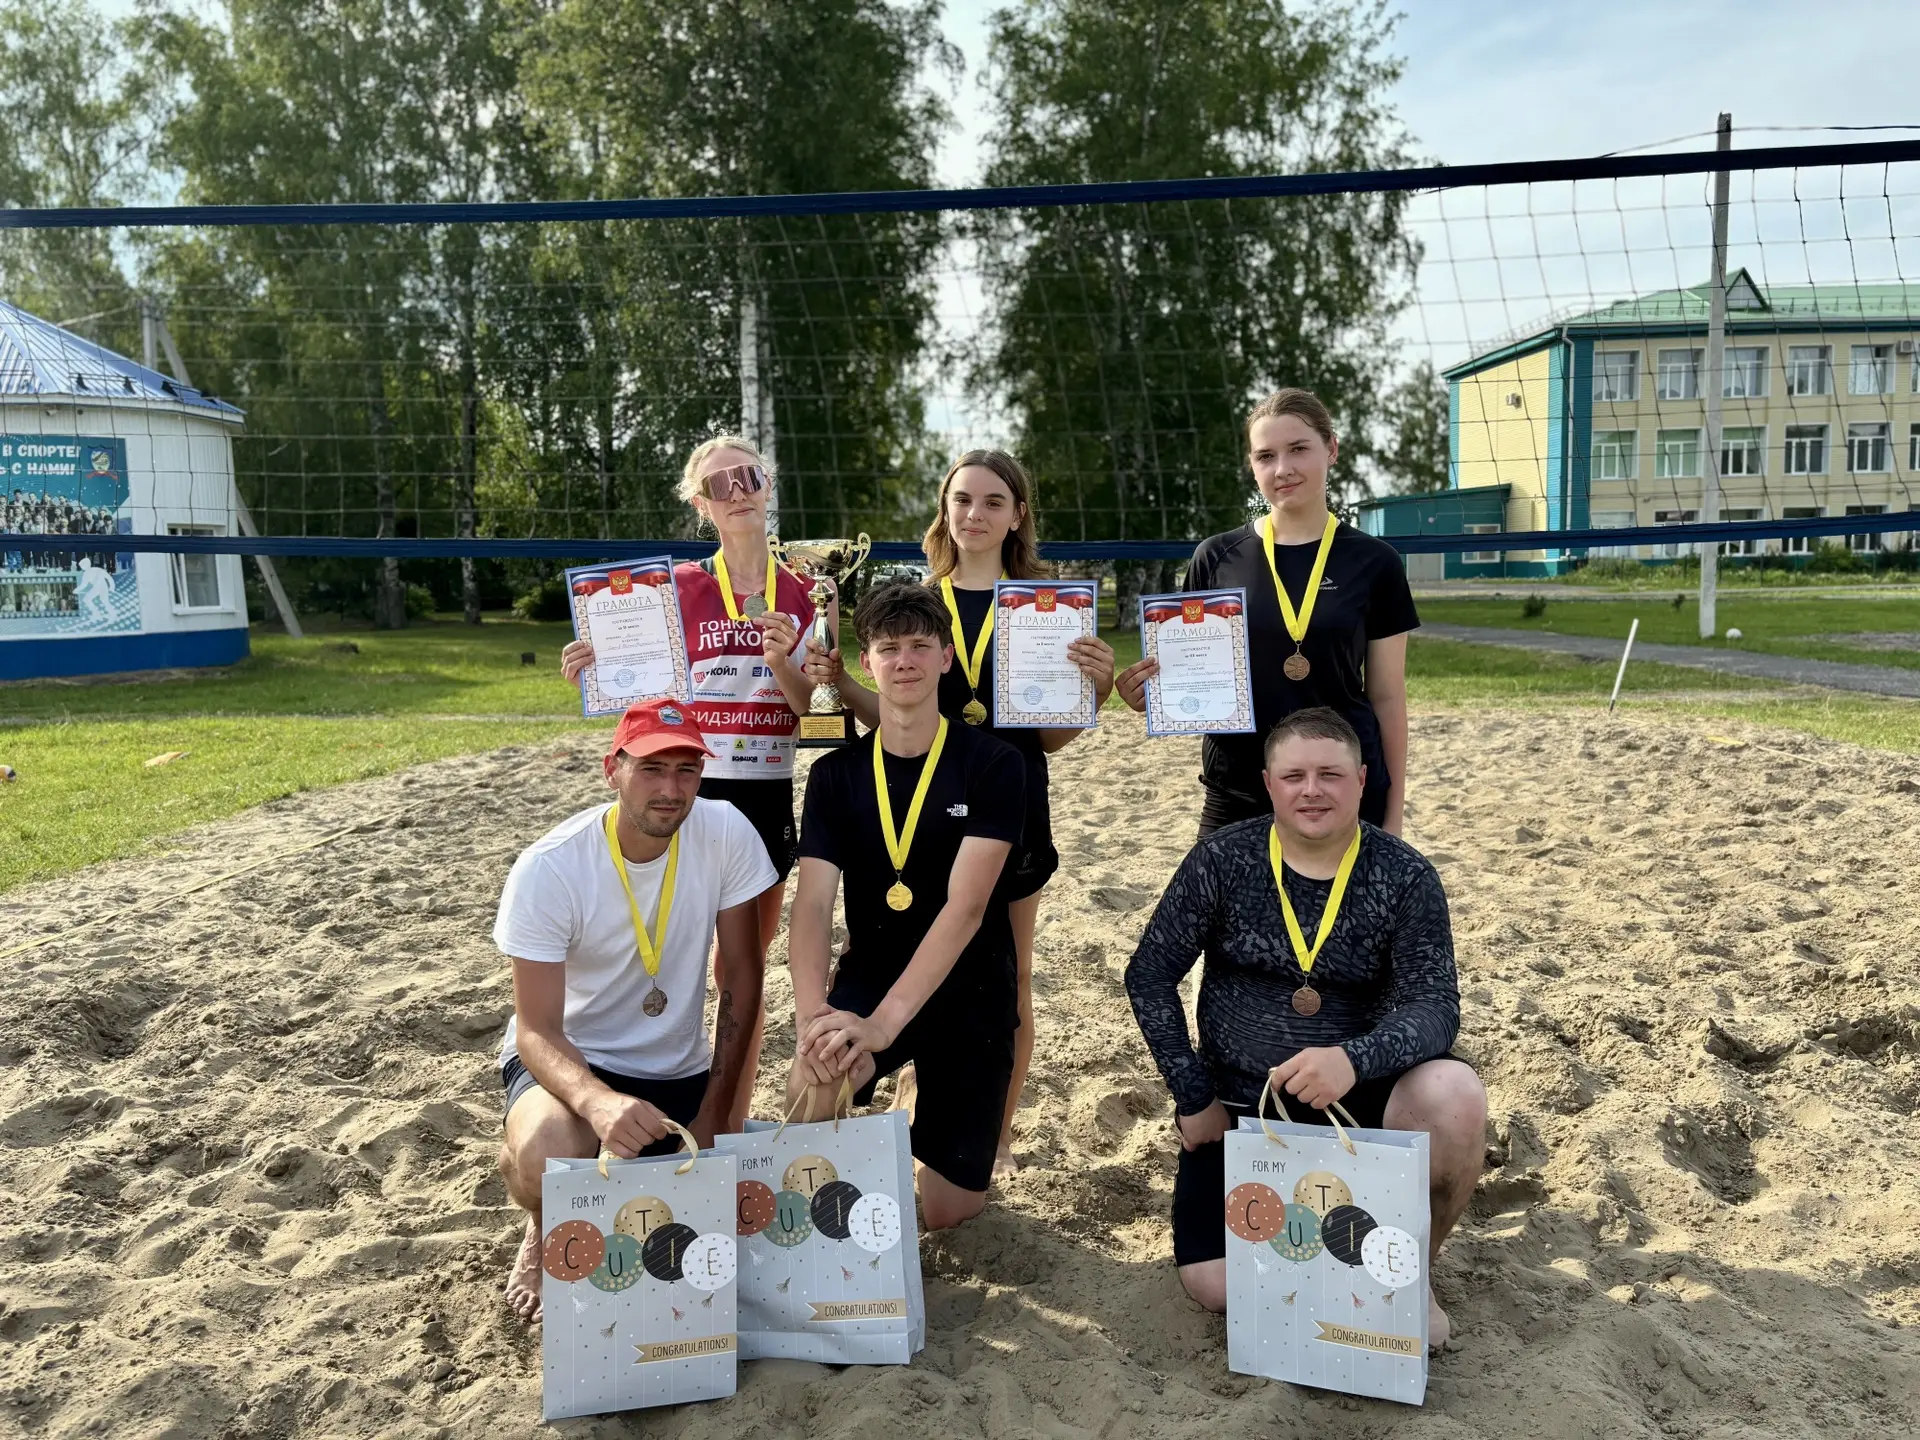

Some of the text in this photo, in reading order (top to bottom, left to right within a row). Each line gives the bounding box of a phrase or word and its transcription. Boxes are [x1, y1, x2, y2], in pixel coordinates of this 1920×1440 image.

[2, 444, 13, 458] В
[11, 462, 22, 475] С
[27, 462, 76, 476] НАМИ!
[596, 595, 653, 611] ГРАМОТА
[699, 619, 754, 634] ГОНКА
[1019, 615, 1072, 626] ГРАМОТА
[1166, 626, 1222, 639] ГРАМОТА
[697, 629, 763, 652] ЛЕГКО
[706, 665, 738, 677] КОЙЛ
[742, 1156, 774, 1171] FOR MY
[1252, 1160, 1287, 1174] FOR MY
[571, 1194, 607, 1209] FOR MY
[824, 1303, 898, 1317] CONGRATULATIONS!
[1331, 1327, 1413, 1353] CONGRATULATIONS!
[652, 1337, 729, 1358] CONGRATULATIONS!
